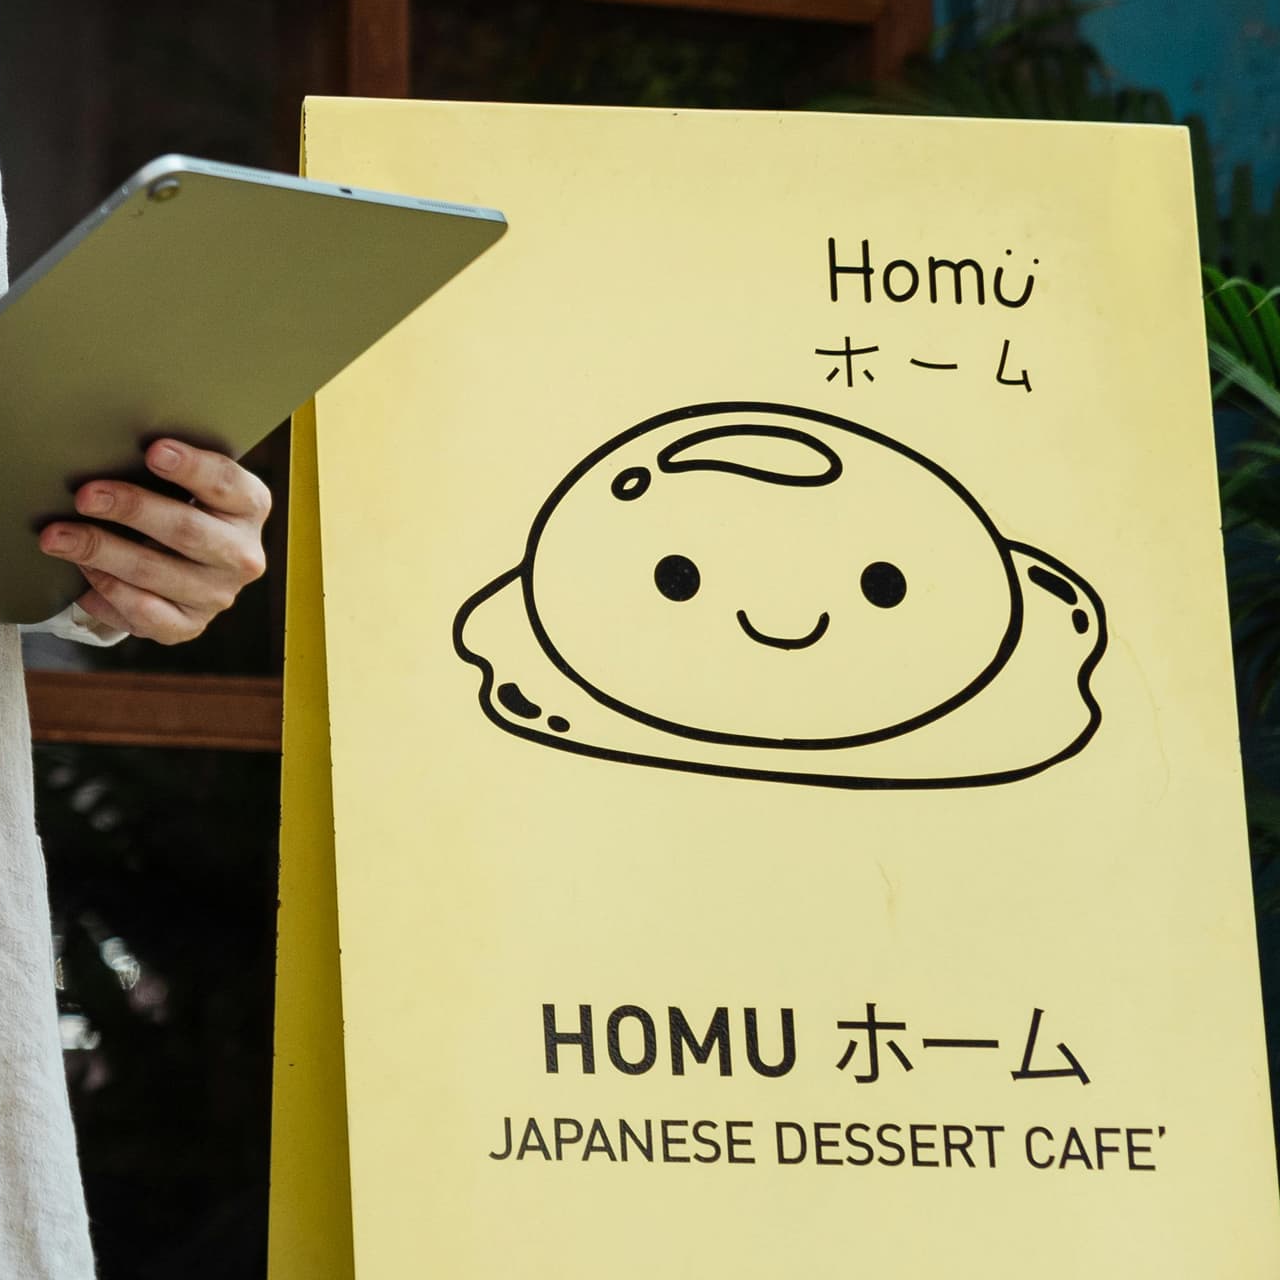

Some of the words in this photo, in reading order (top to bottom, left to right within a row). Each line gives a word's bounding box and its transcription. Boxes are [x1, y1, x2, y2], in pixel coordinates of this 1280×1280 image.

[814, 336, 1033, 393] ホーム
[542, 1003, 797, 1078] HOMU
[836, 1002, 1091, 1086] ホーム
[488, 1116, 756, 1165] JAPANESE
[775, 1121, 1005, 1169] DESSERT
